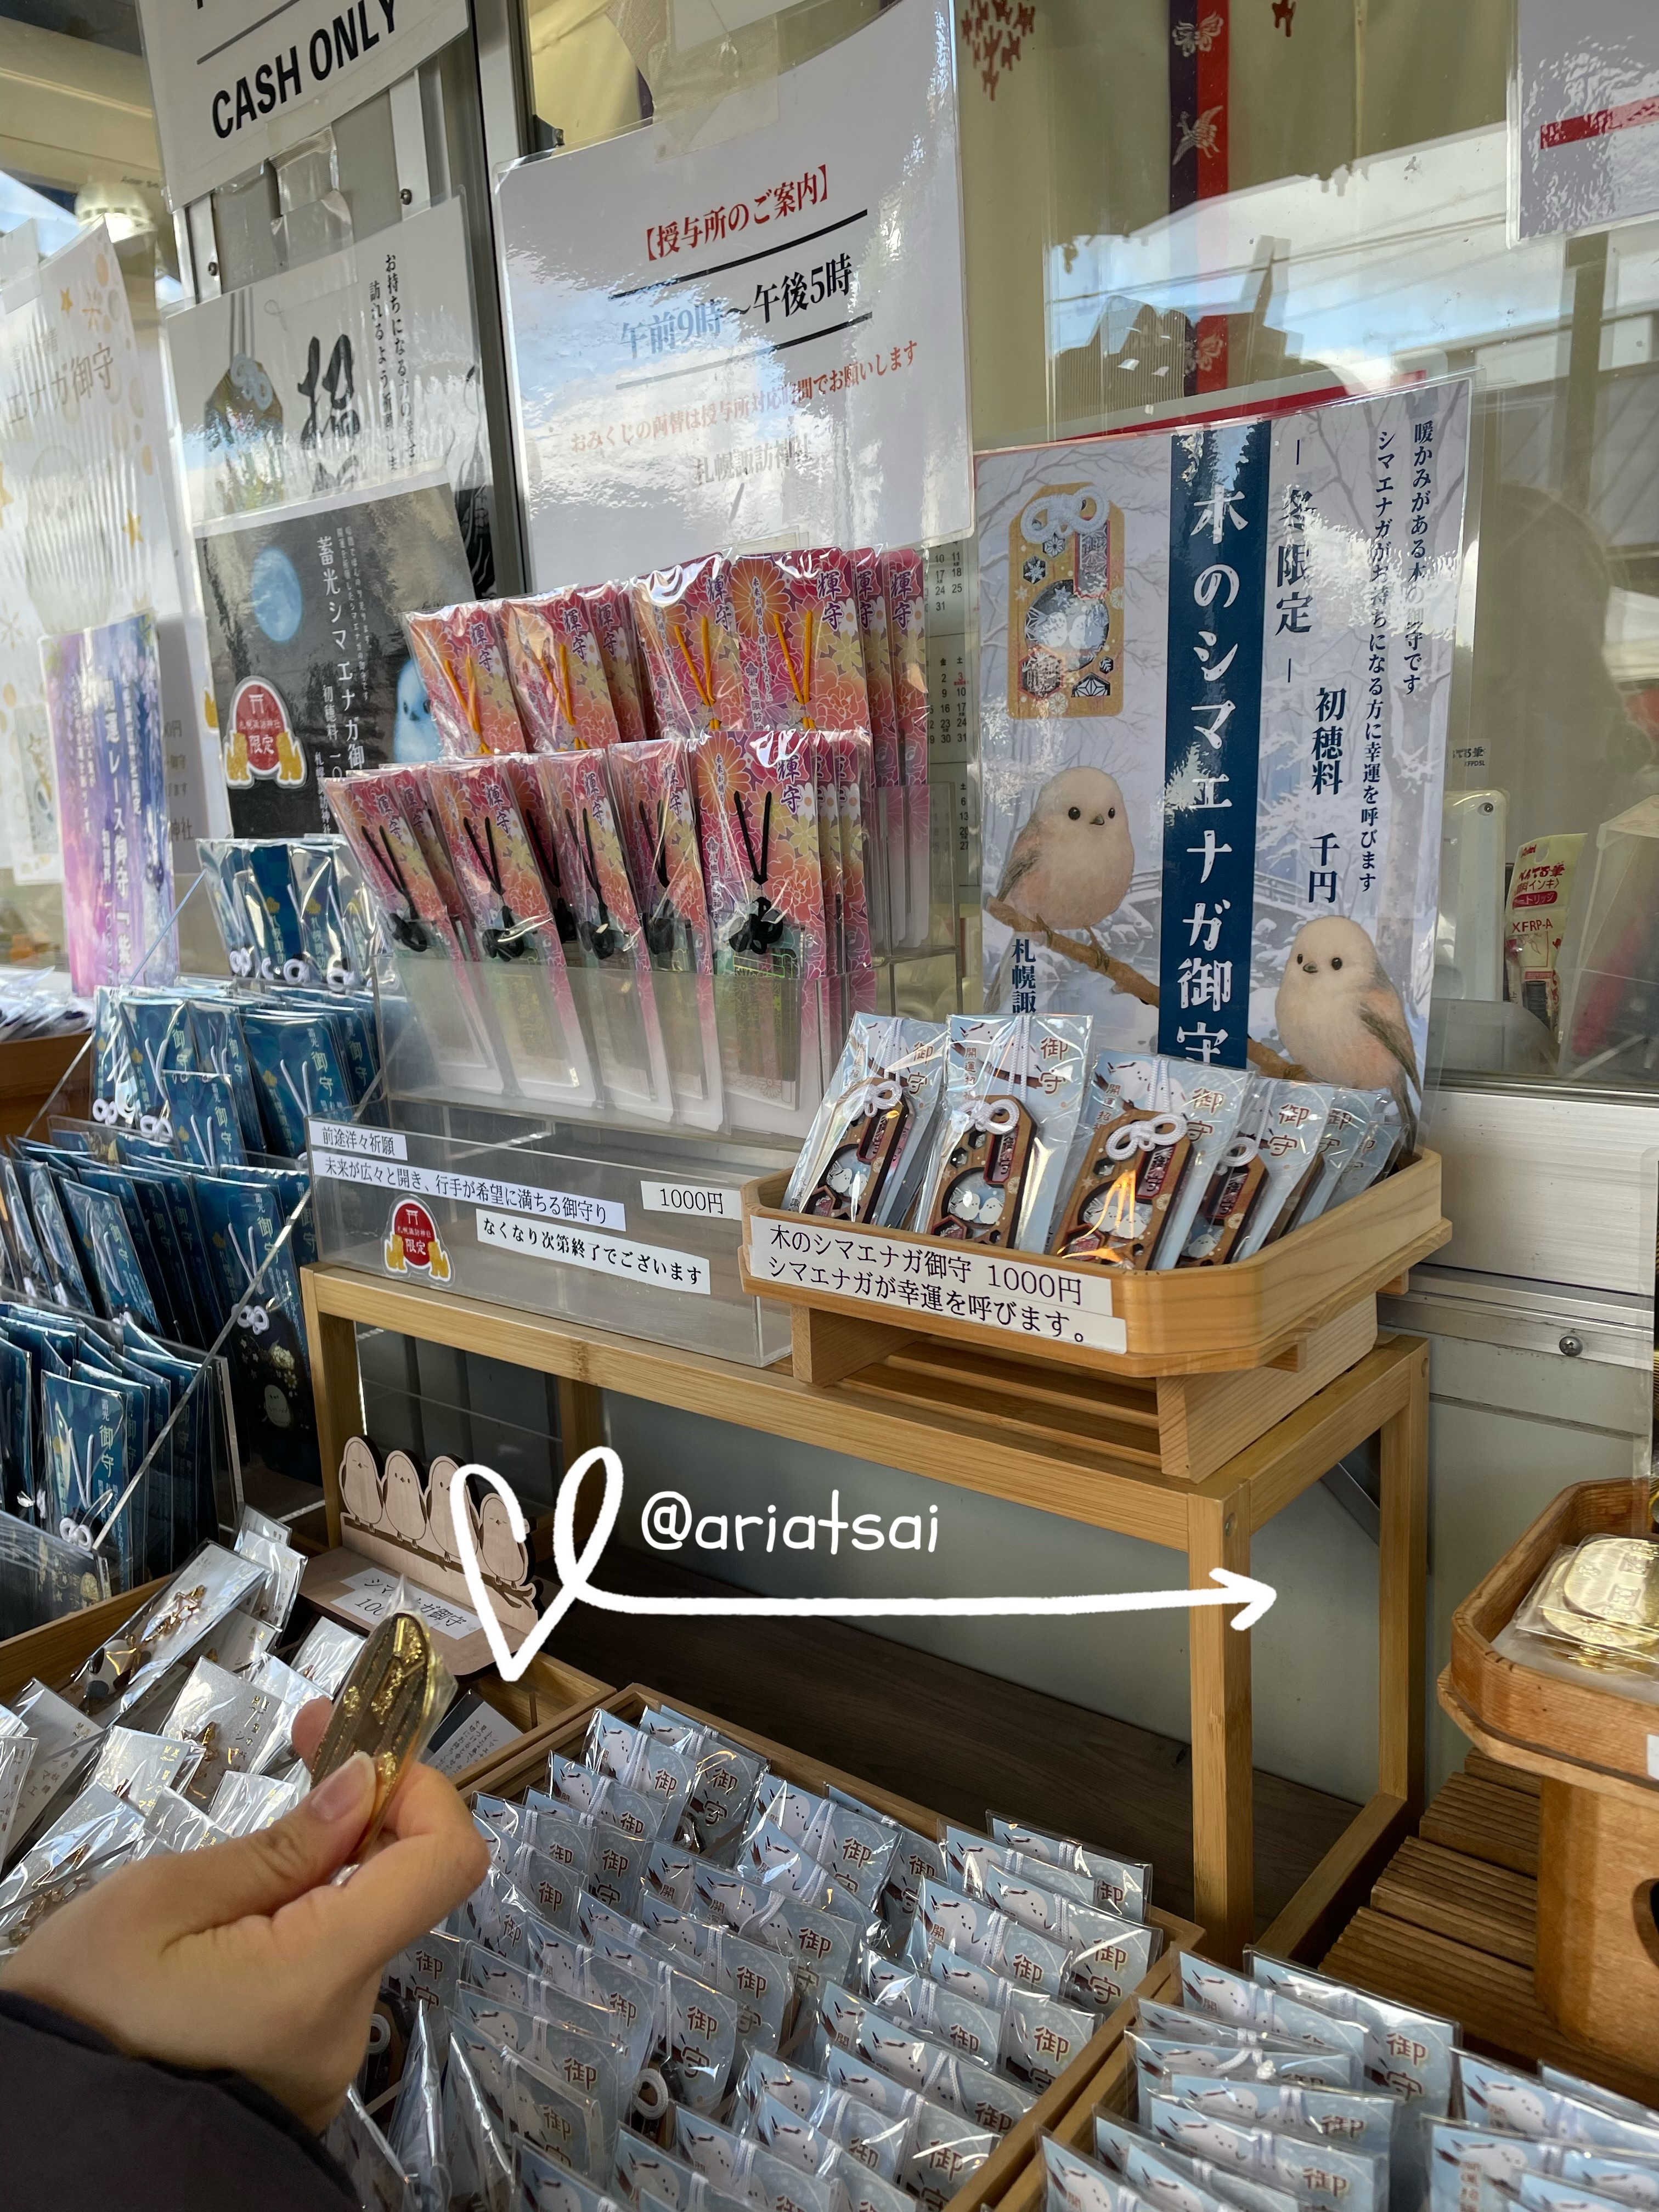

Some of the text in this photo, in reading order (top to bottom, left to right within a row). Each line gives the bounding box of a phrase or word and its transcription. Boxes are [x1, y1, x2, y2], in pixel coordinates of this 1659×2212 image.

[212, 0, 396, 139] CASH ONLY
[646, 164, 829, 262] 【授与所のご案内】
[935, 552, 960, 563] 10 11
[936, 568, 962, 579] 17 18
[707, 576, 732, 631] 輝守
[817, 571, 844, 631] 輝守
[890, 571, 913, 629] 輝守
[935, 584, 962, 595] 24 25
[936, 602, 945, 611] 31
[317, 535, 365, 770] 蓄光シマエナガ御
[752, 576, 773, 702] 未来が明るく輝きますように
[941, 672, 963, 682] 2 3
[942, 687, 966, 697] 9 10
[941, 703, 966, 713] 16 17
[941, 719, 950, 729] 23
[957, 718, 967, 727] 24
[249, 734, 274, 754] 限定
[941, 734, 951, 743] 30
[957, 733, 967, 742] 31
[777, 754, 802, 814] 輝守
[1177, 485, 1249, 1064] 木のシマエナガ御守
[1308, 687, 1347, 904] 初穂料 千円
[486, 785, 510, 834] 輝守
[960, 812, 968, 821] 13
[961, 797, 966, 806] 6
[960, 827, 968, 836] 20
[960, 841, 968, 850] 27
[1512, 918, 1553, 933] XFRP-A
[1011, 939, 1037, 1014] 札幌諏
[311, 1051, 333, 1097] 御守
[1037, 1036, 1069, 1096] 御守
[215, 1105, 233, 1153] 御守
[1185, 1087, 1225, 1143] 御守
[1268, 1103, 1310, 1158] 御守
[322, 1126, 395, 1156] 前途洋々祈願
[325, 1158, 607, 1224] 未来が広々と開き、行手が希望に満ちる御守り
[659, 1188, 724, 1215] 1000円
[405, 1239, 426, 1257] 限定
[484, 1218, 702, 1285] なくなり次第終了でございます
[770, 1224, 1082, 1307] 木のシマエナガ御守 1000円
[769, 1257, 1085, 1344] シマエナガが幸運を呼びます。
[99, 1425, 115, 1478] 御守
[654, 1769, 677, 1798] 御
[704, 1769, 738, 1825] 御守
[1087, 1939, 1128, 2005] 御守
